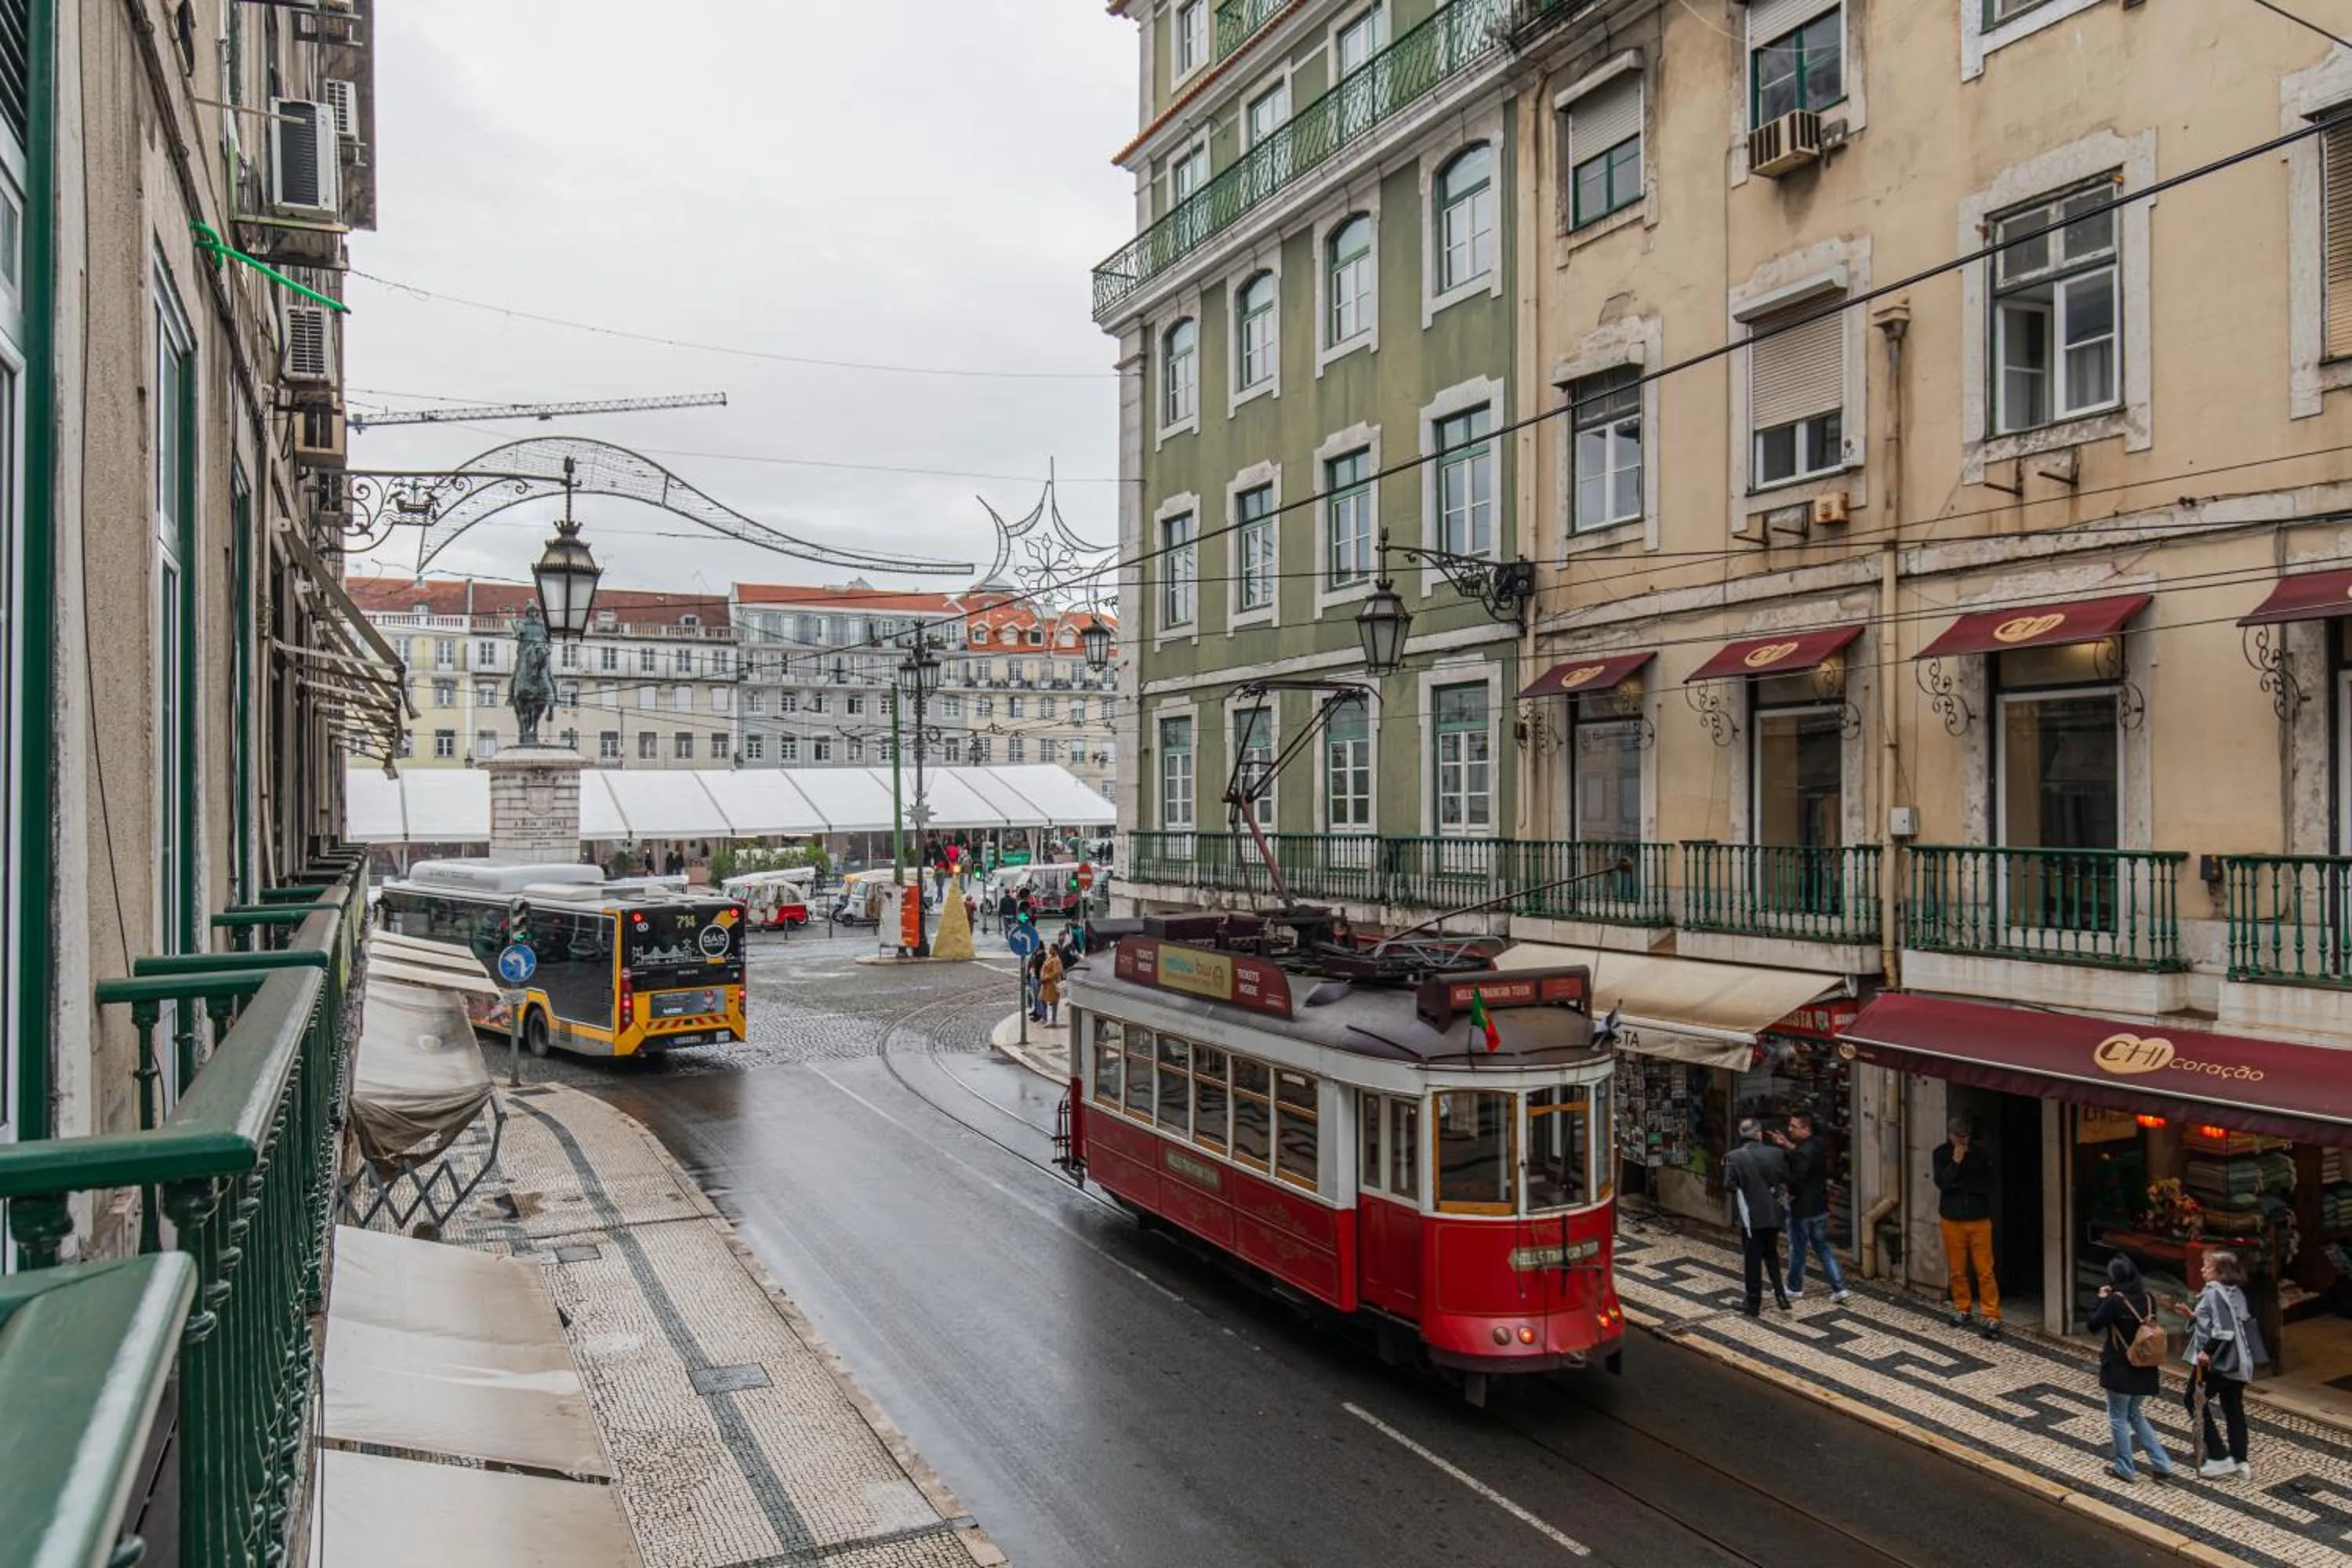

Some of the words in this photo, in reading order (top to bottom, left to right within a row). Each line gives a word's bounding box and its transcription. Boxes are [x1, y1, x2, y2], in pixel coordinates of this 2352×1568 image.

[677, 915, 695, 928] 714
[1236, 968, 1260, 982] TICKETS
[1240, 983, 1258, 996] INSIDE
[2100, 1040, 2166, 1067] CHI
[2169, 1058, 2264, 1081] coração
